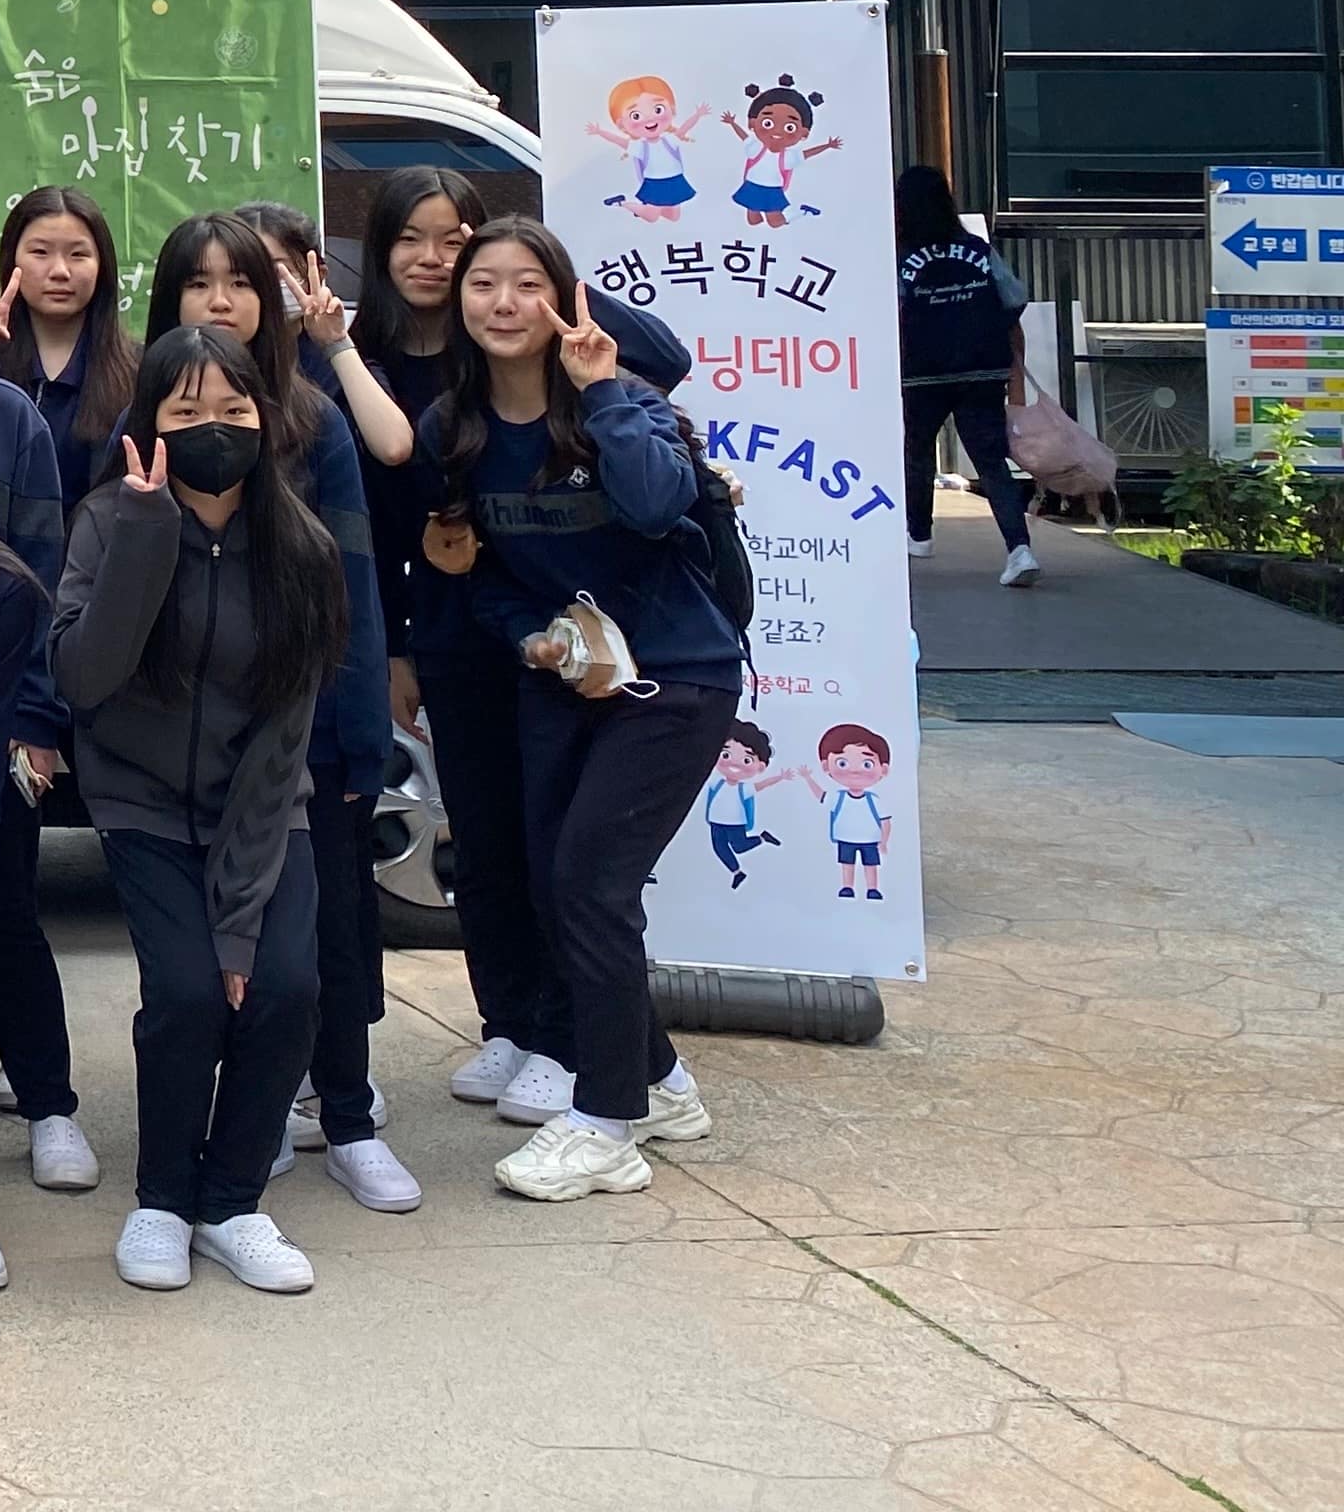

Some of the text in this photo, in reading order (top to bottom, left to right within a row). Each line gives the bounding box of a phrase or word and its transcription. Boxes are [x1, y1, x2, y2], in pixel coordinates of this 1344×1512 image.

[14, 49, 81, 107] 숨은
[62, 96, 262, 183] 맛집 찾기
[1243, 237, 1297, 254] 교무실
[594, 240, 840, 314] 행복학교
[683, 335, 859, 392] 닝데이
[708, 420, 896, 521] KFAST
[758, 577, 816, 604] 다니,
[760, 619, 825, 644] 같죠?
[742, 674, 814, 695] 자중학교
